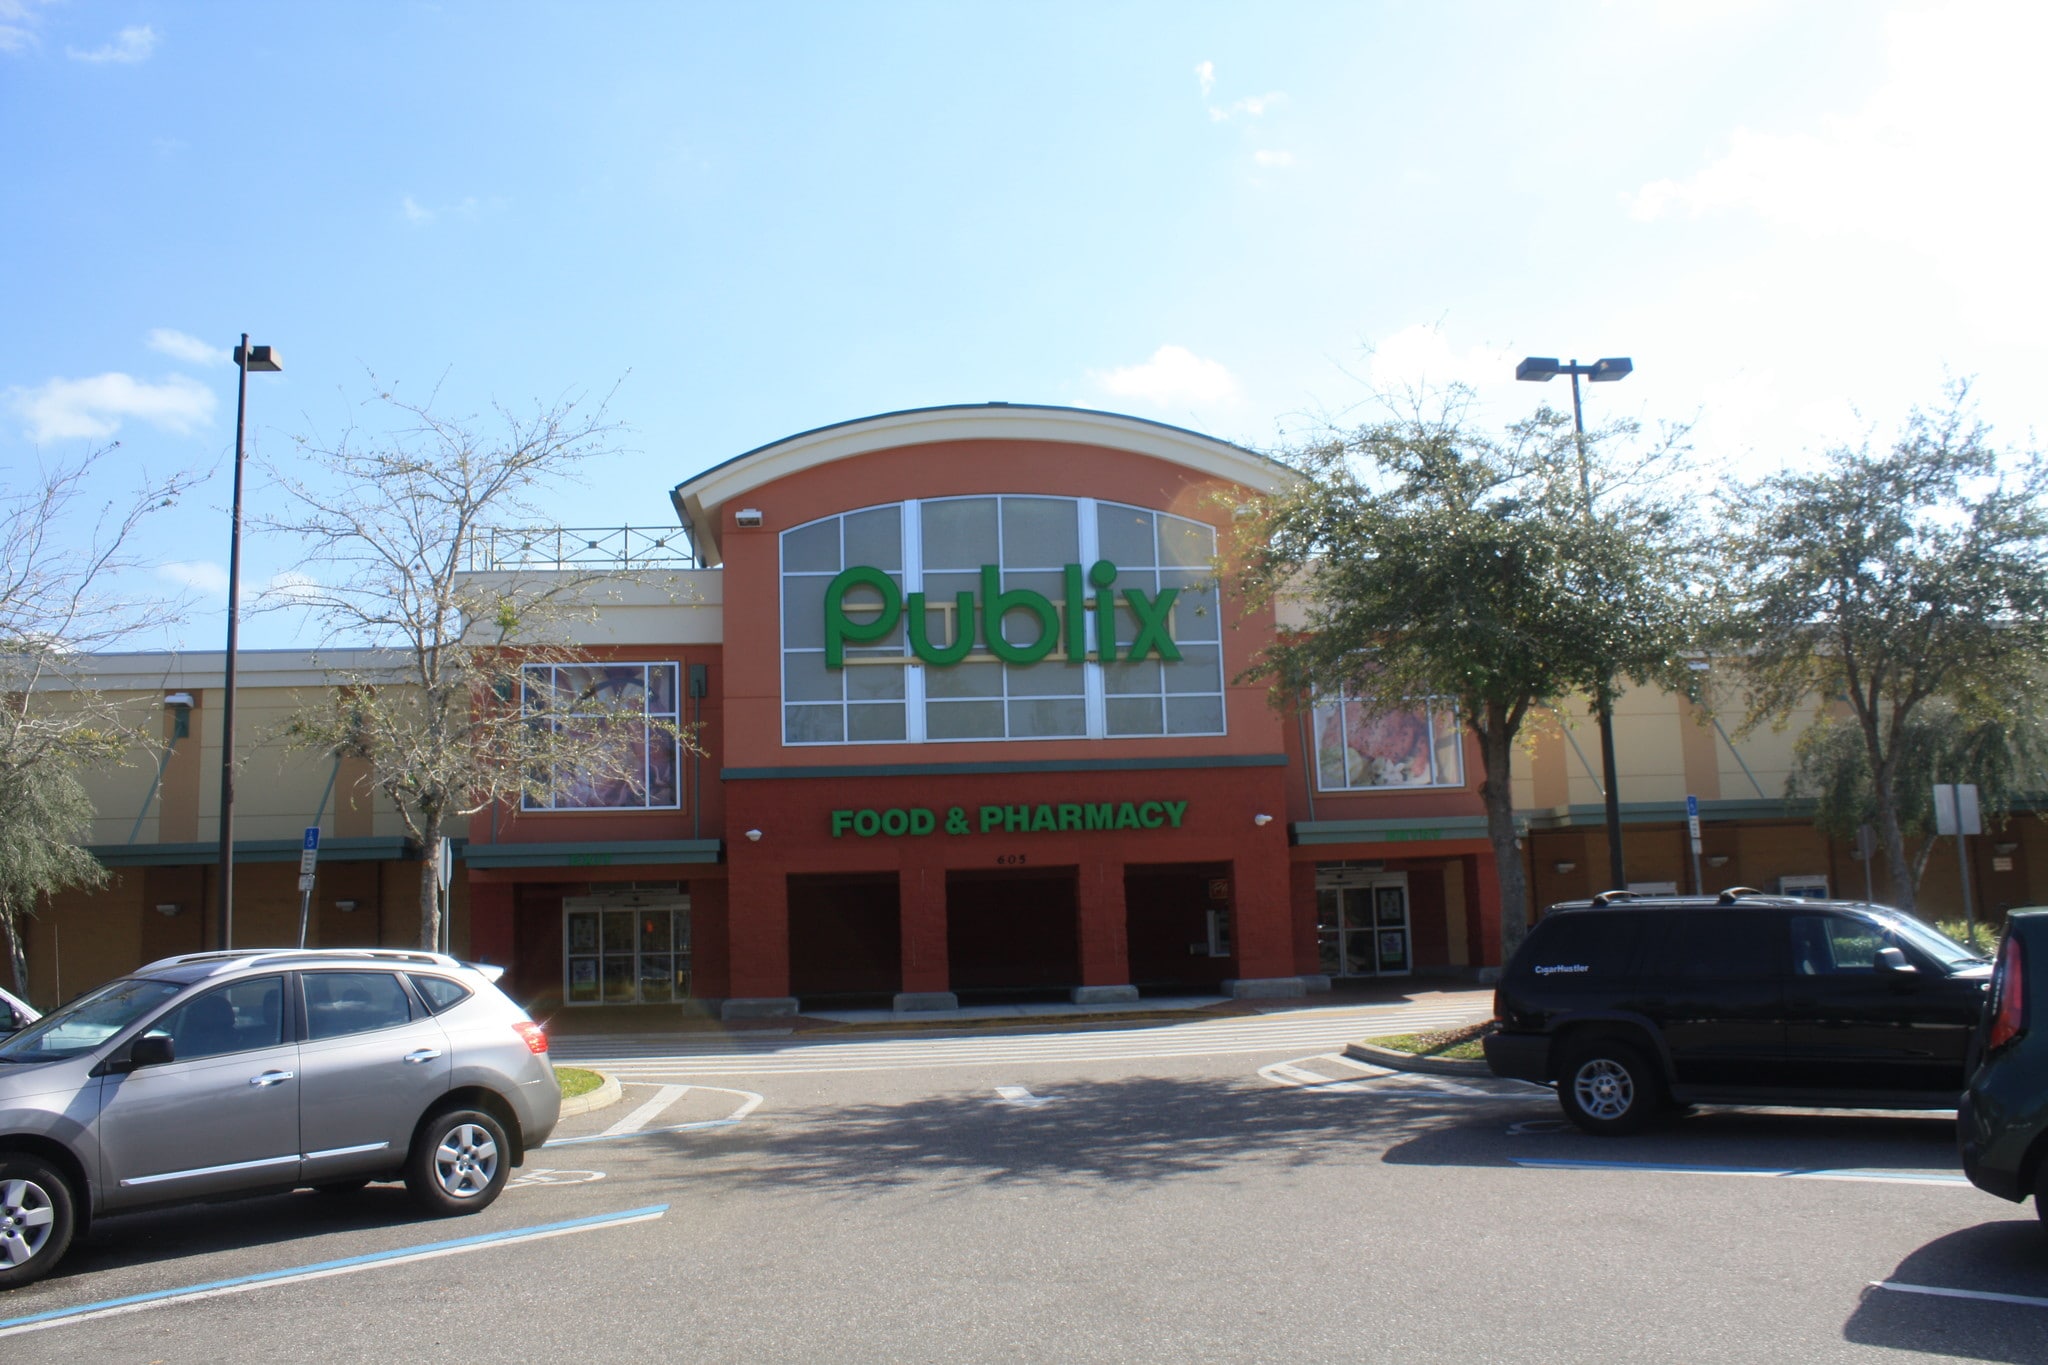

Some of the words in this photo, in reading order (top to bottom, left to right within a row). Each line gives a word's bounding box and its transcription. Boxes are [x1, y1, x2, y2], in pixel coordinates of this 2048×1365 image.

[825, 560, 1182, 670] Publix
[832, 808, 936, 837] FOOD
[945, 807, 971, 834] &
[980, 801, 1188, 833] PHARMACY
[997, 854, 1026, 865] 605
[1535, 964, 1590, 976] CigarHustler
